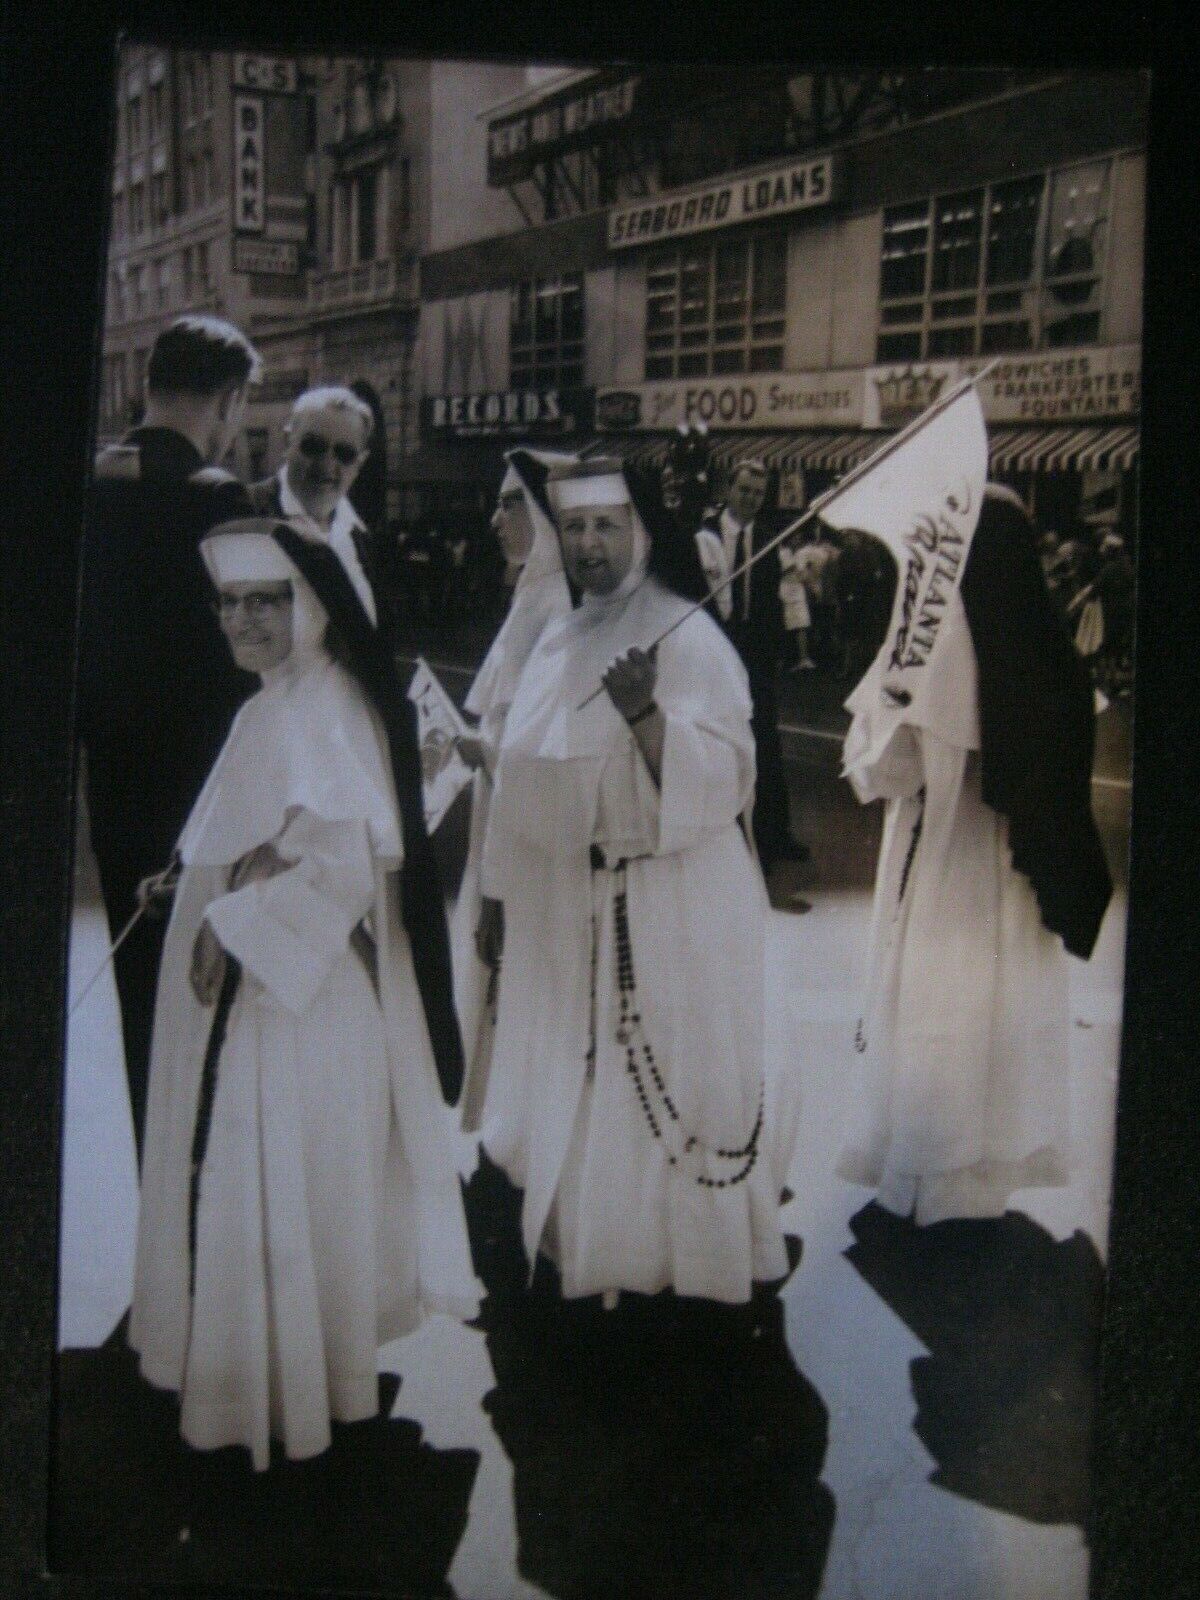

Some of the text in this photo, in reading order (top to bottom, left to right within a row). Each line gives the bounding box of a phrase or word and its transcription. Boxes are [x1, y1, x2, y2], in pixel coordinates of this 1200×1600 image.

[240, 105, 258, 222] BANK
[742, 164, 825, 213] LOANS
[967, 356, 1090, 379] SNDWICHES
[432, 390, 560, 427] RECORDS
[685, 385, 757, 422] FOOD
[1020, 394, 1119, 417] FOUNTAIN
[902, 514, 964, 668] ATLANTA
